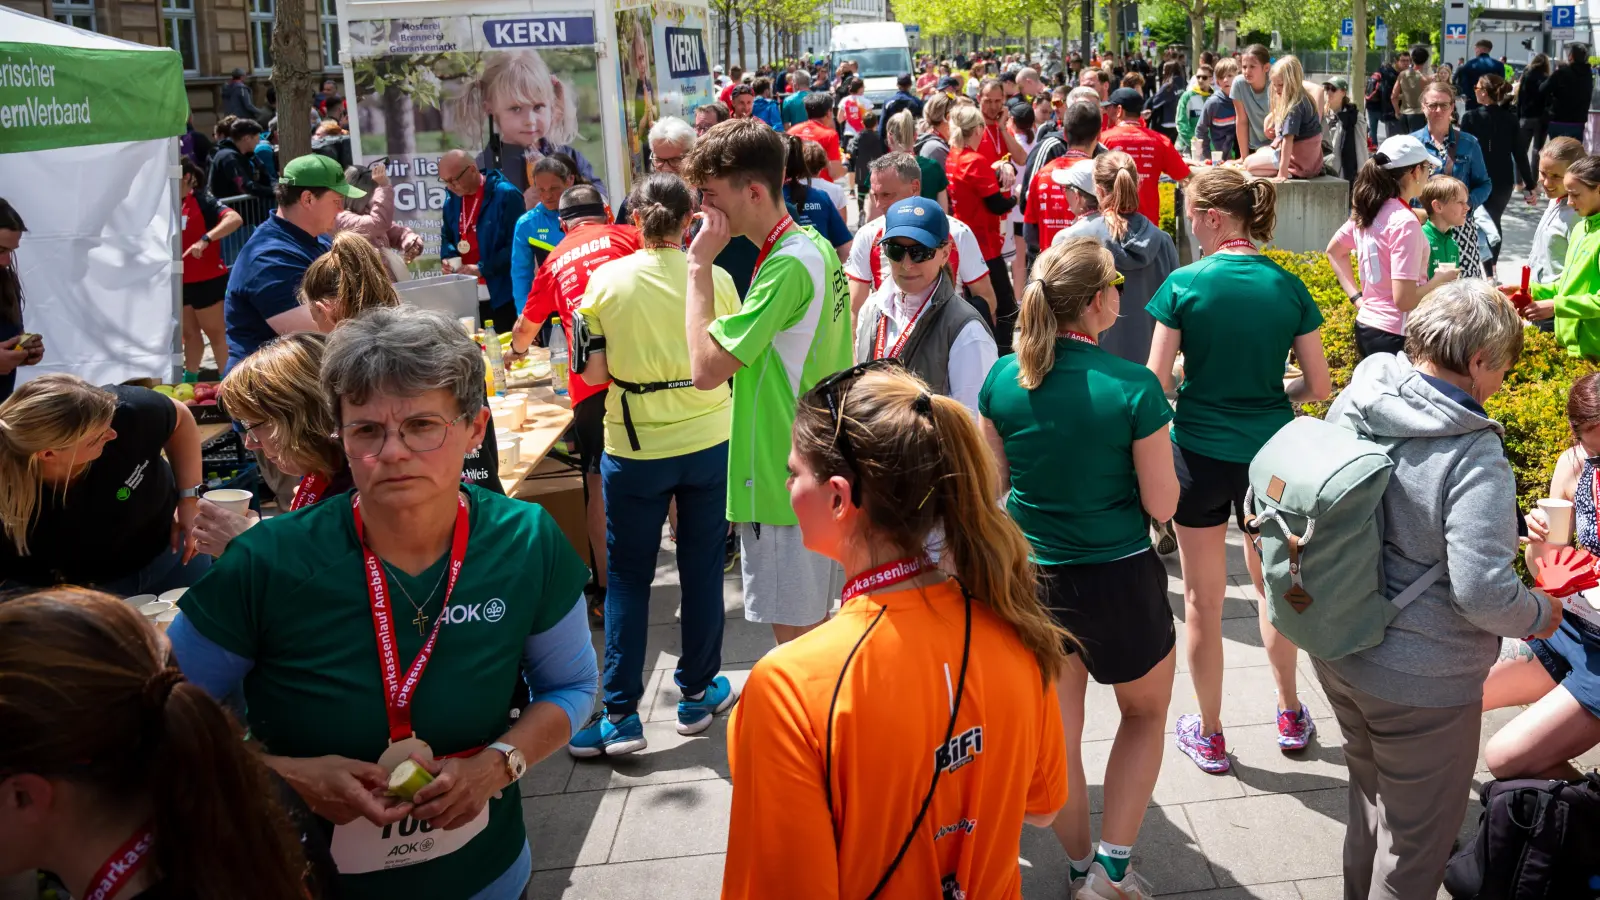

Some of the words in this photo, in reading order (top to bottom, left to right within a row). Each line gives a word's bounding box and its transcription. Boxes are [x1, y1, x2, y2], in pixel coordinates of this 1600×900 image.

[401, 22, 441, 31] Mosterei
[1557, 8, 1570, 25] P
[400, 32, 445, 42] Brennerei
[494, 21, 567, 44] KERN
[669, 33, 701, 72] KERN
[0, 96, 91, 128] ernVerband
[414, 156, 441, 176] lie
[551, 235, 612, 278] ANSBACH
[365, 556, 386, 609] Ansbach
[434, 603, 482, 626] AOK
[396, 654, 428, 708] Ansbach
[935, 726, 982, 773] BiFi
[387, 841, 420, 857] AOK
